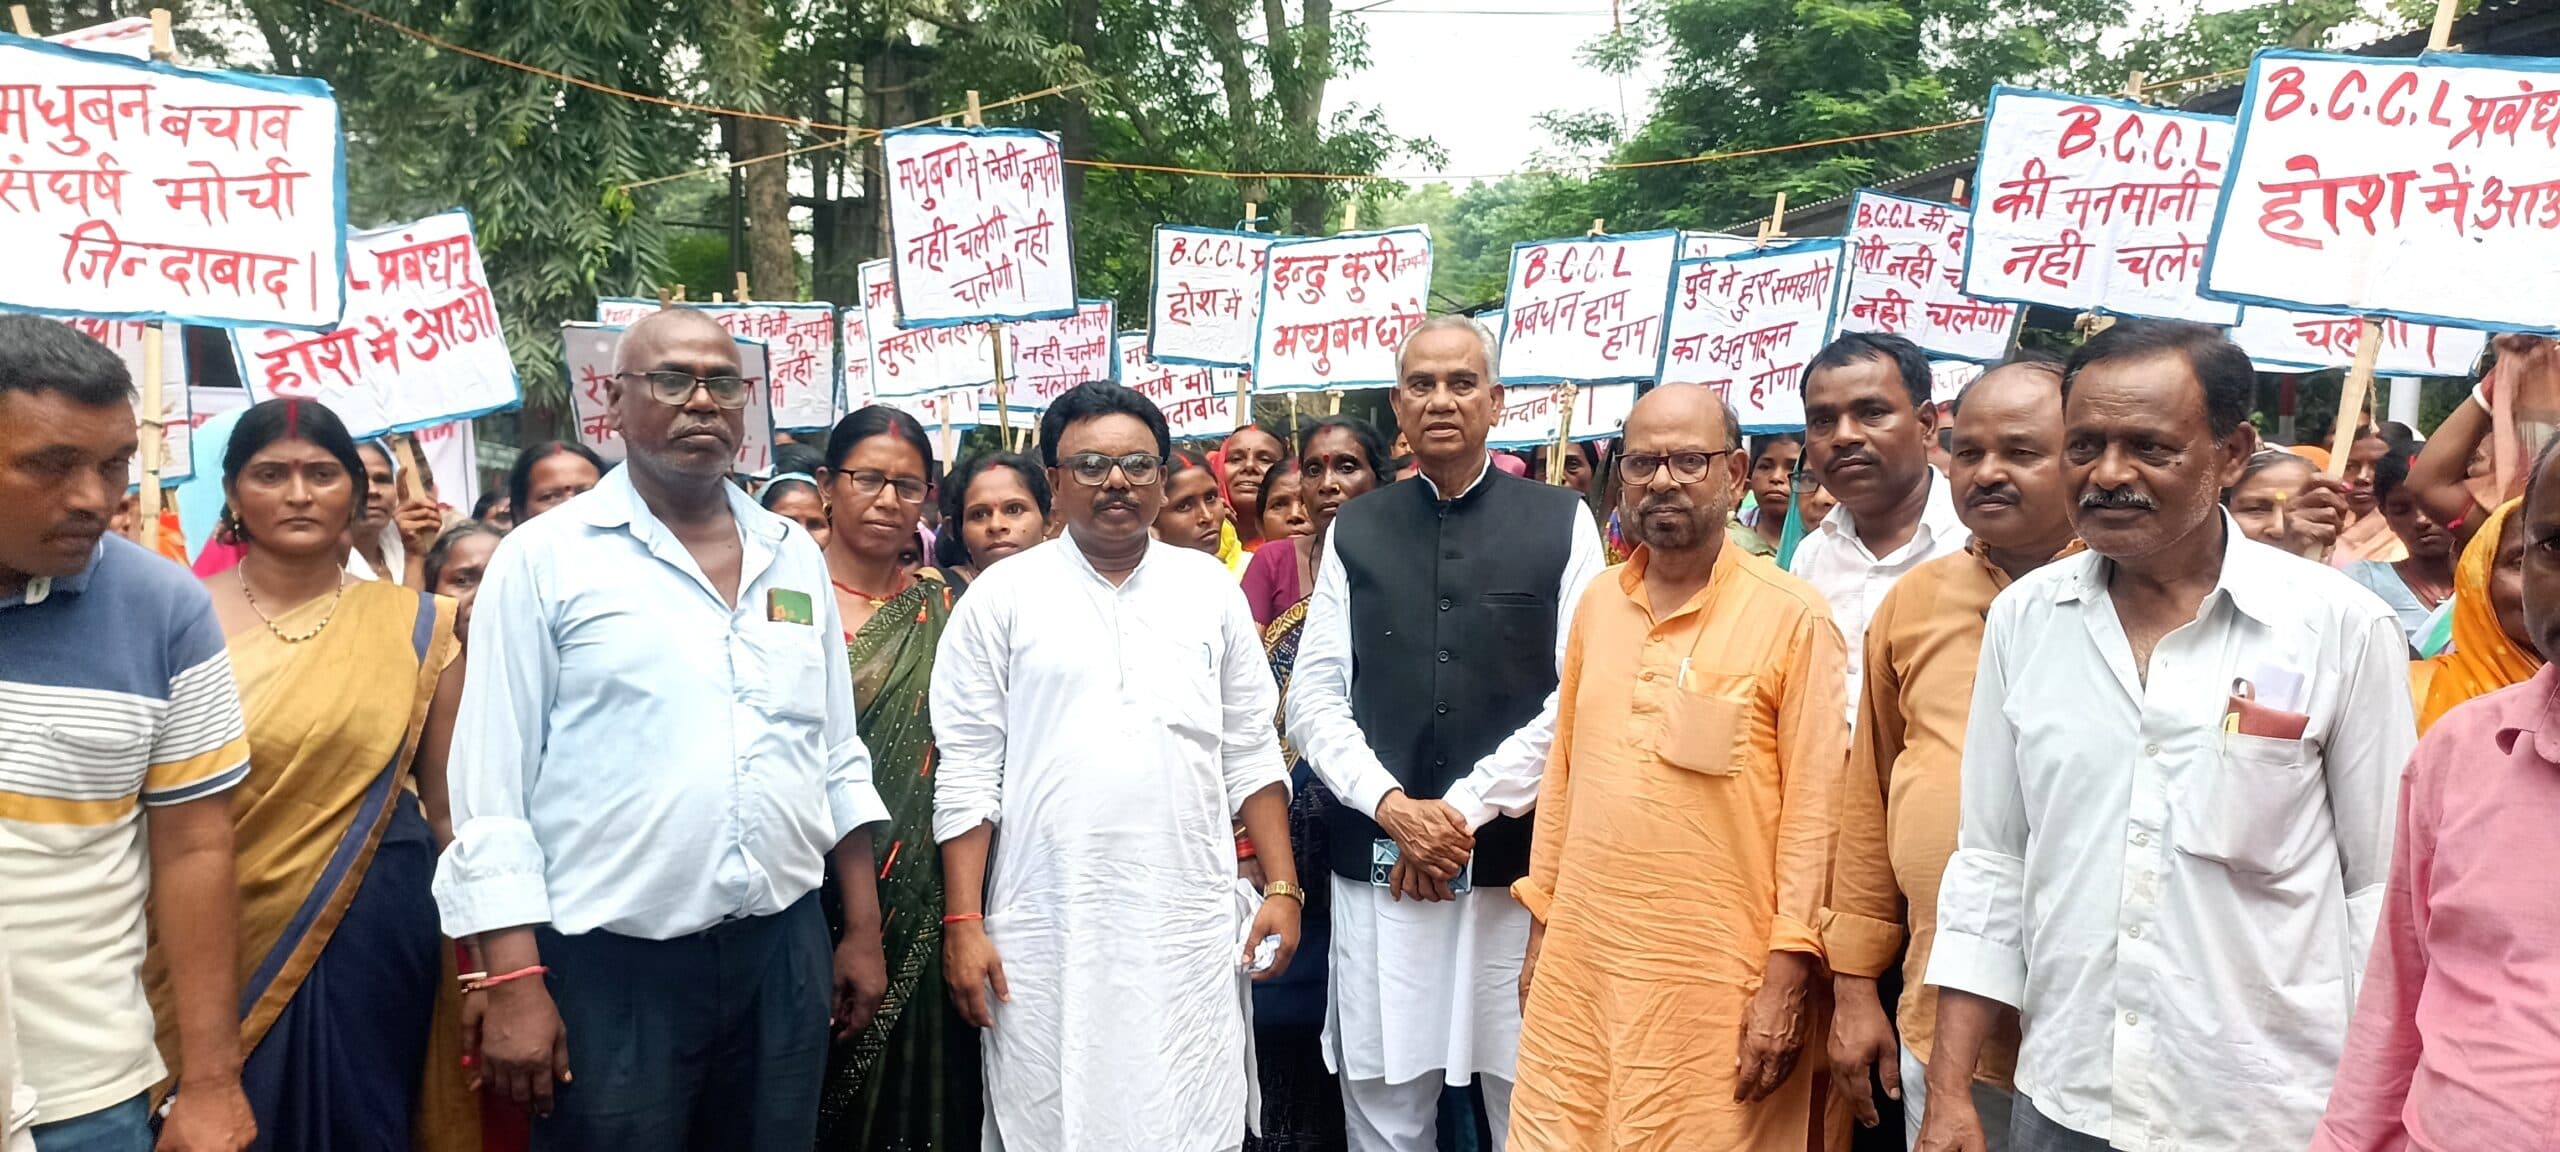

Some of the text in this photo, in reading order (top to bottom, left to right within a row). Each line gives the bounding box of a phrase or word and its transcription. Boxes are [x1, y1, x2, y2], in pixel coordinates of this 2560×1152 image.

[0, 83, 303, 157] मधुबन बचाव
[2264, 66, 2451, 128] B.C.C.L
[2058, 104, 2221, 171] B.C.C.L
[0, 152, 132, 217] संघर्ष
[897, 141, 968, 212] मधुबन
[1992, 157, 2220, 231] की मनमानी
[2258, 154, 2421, 250] होश
[2419, 162, 2475, 238] में
[908, 205, 1054, 273] नही चलेगी नही
[1857, 203, 1915, 228] B.C.C.L
[1918, 206, 1953, 234] की
[1887, 244, 1938, 290] नही
[2003, 229, 2096, 288] नही
[1166, 281, 1229, 326] होश
[1851, 288, 1914, 333] नही
[1672, 333, 1709, 365] का
